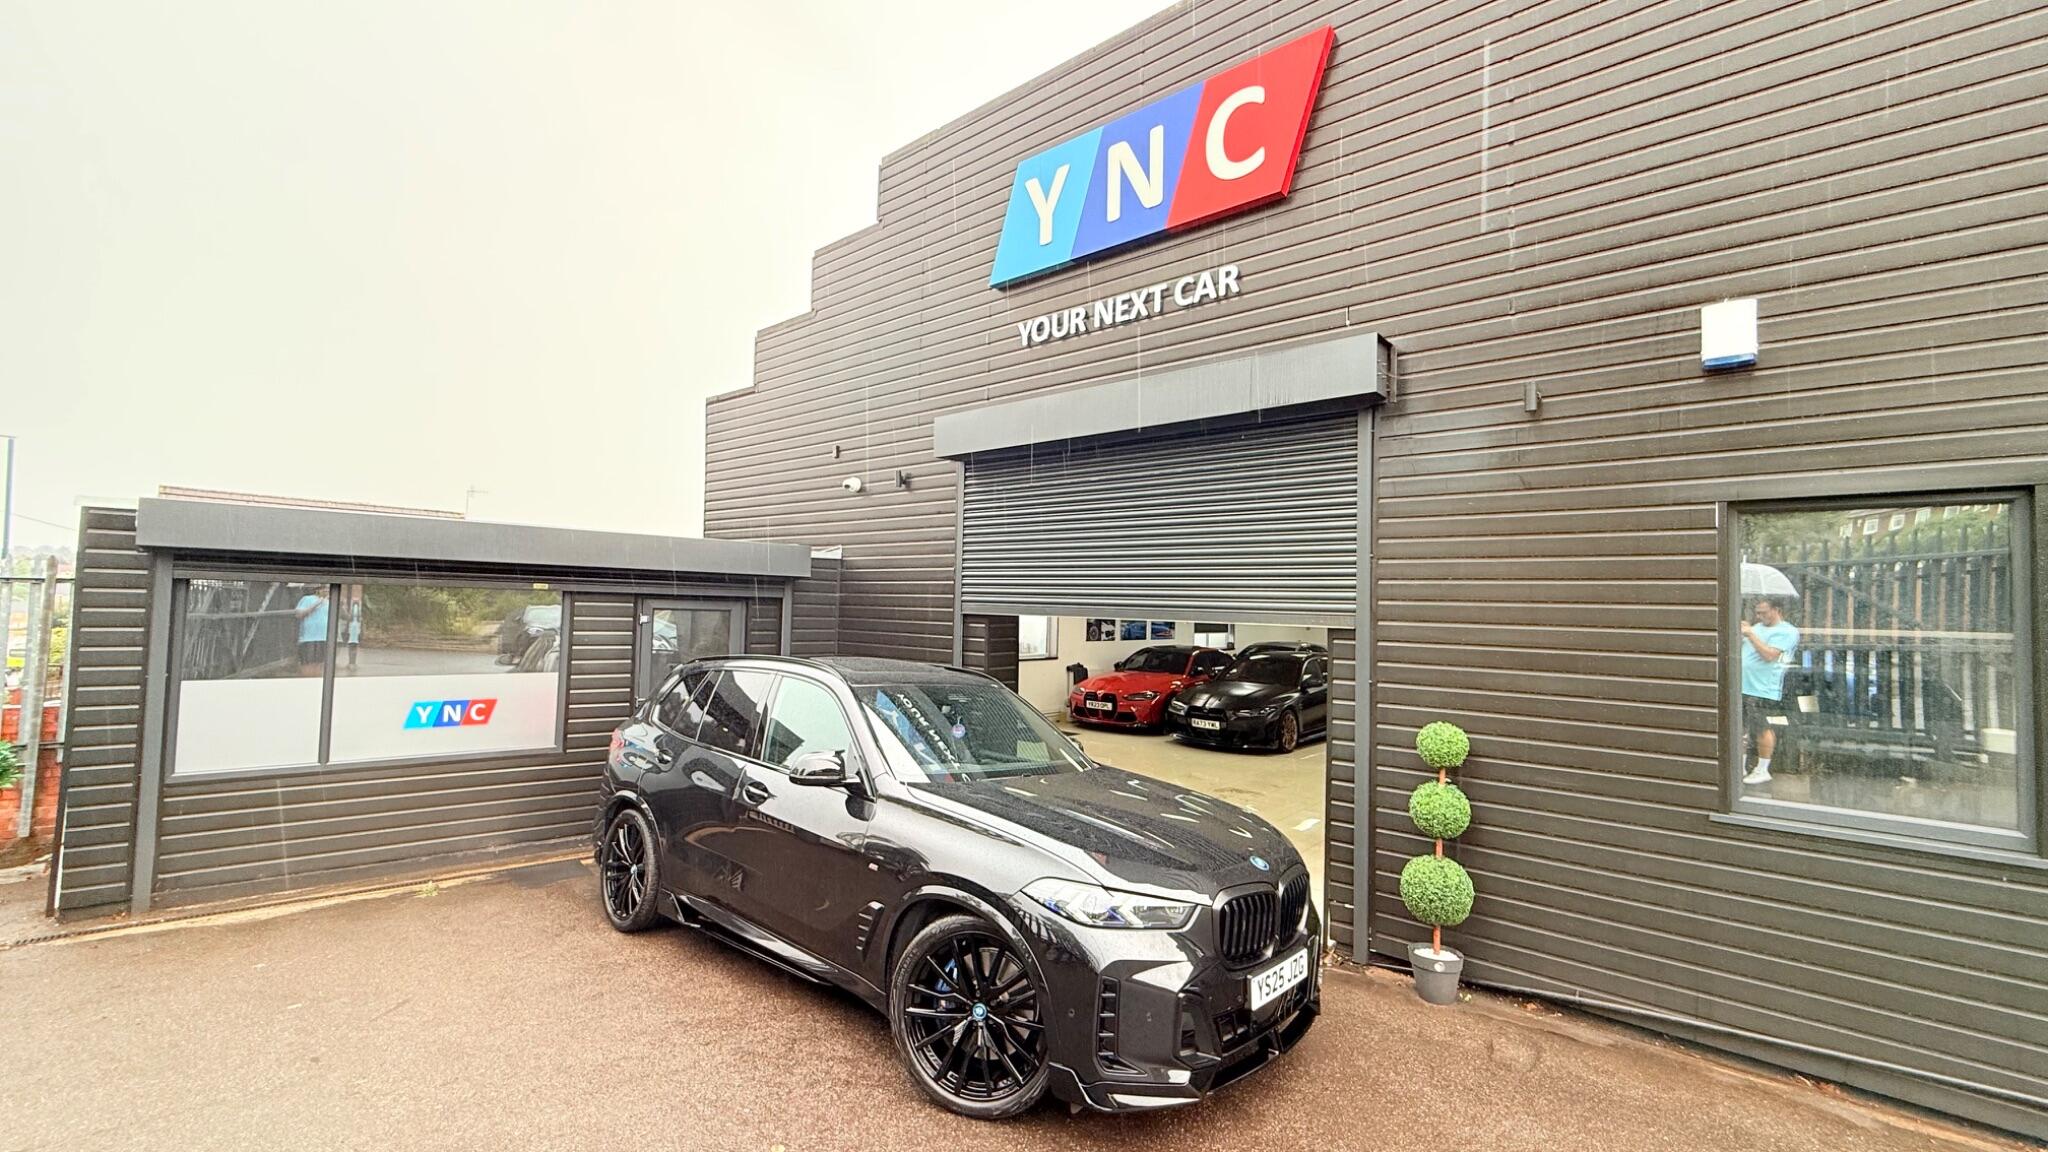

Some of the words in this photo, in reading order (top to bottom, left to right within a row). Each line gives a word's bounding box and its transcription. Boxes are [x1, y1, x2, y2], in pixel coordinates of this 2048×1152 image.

[1025, 86, 1265, 246] YNC
[1017, 306, 1087, 347] YOUR
[1093, 282, 1169, 328] NEXT
[1173, 264, 1240, 307] CAR
[416, 703, 486, 724] YNC
[1257, 966, 1285, 1001] YS25
[1287, 954, 1305, 983] JZG
